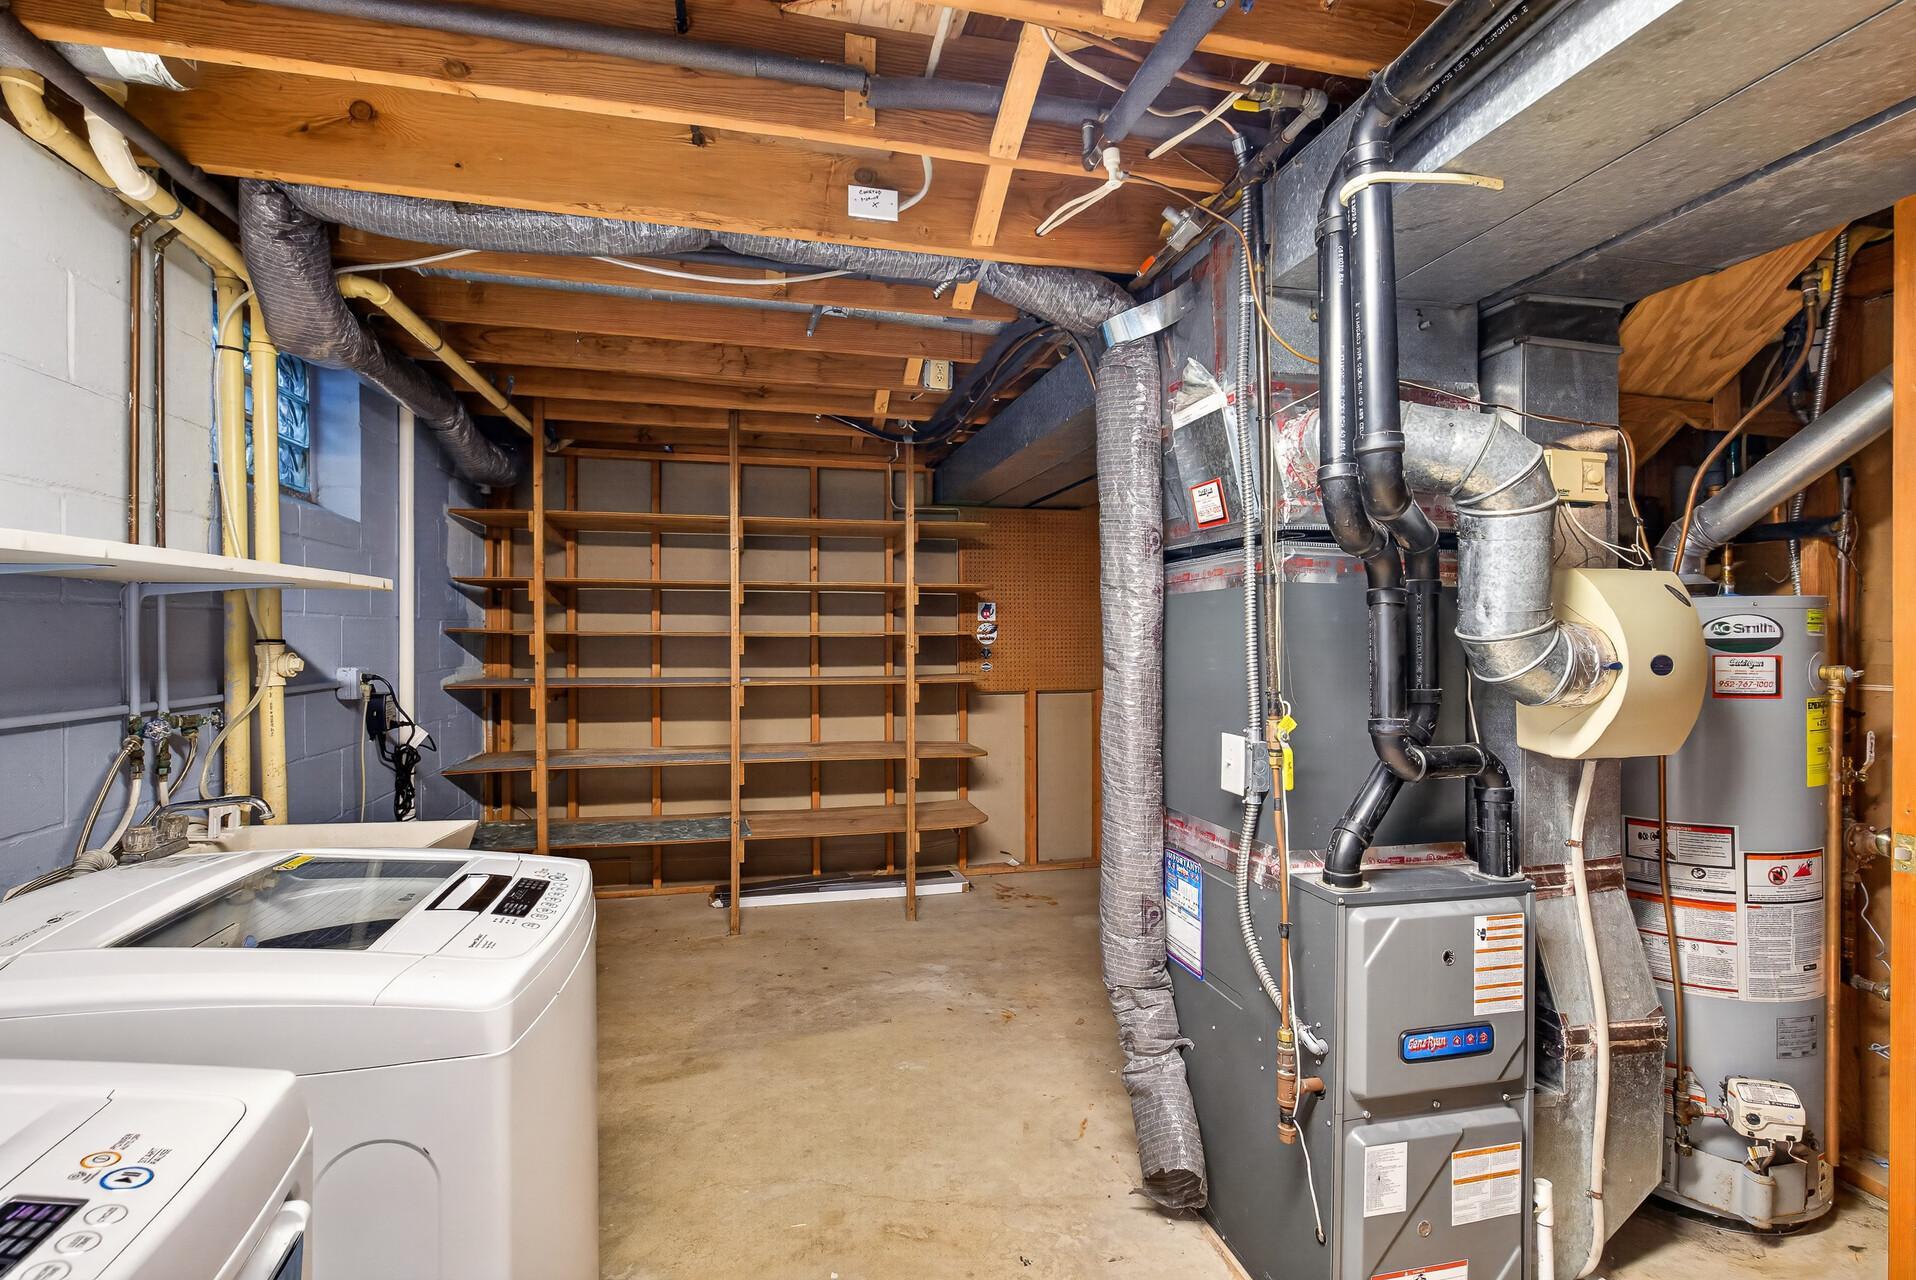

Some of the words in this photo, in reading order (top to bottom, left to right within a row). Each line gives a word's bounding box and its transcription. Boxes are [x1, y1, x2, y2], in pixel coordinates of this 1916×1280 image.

[1470, 44, 1485, 58] PIPE
[1441, 72, 1453, 85] SCH
[1431, 84, 1440, 93] 40
